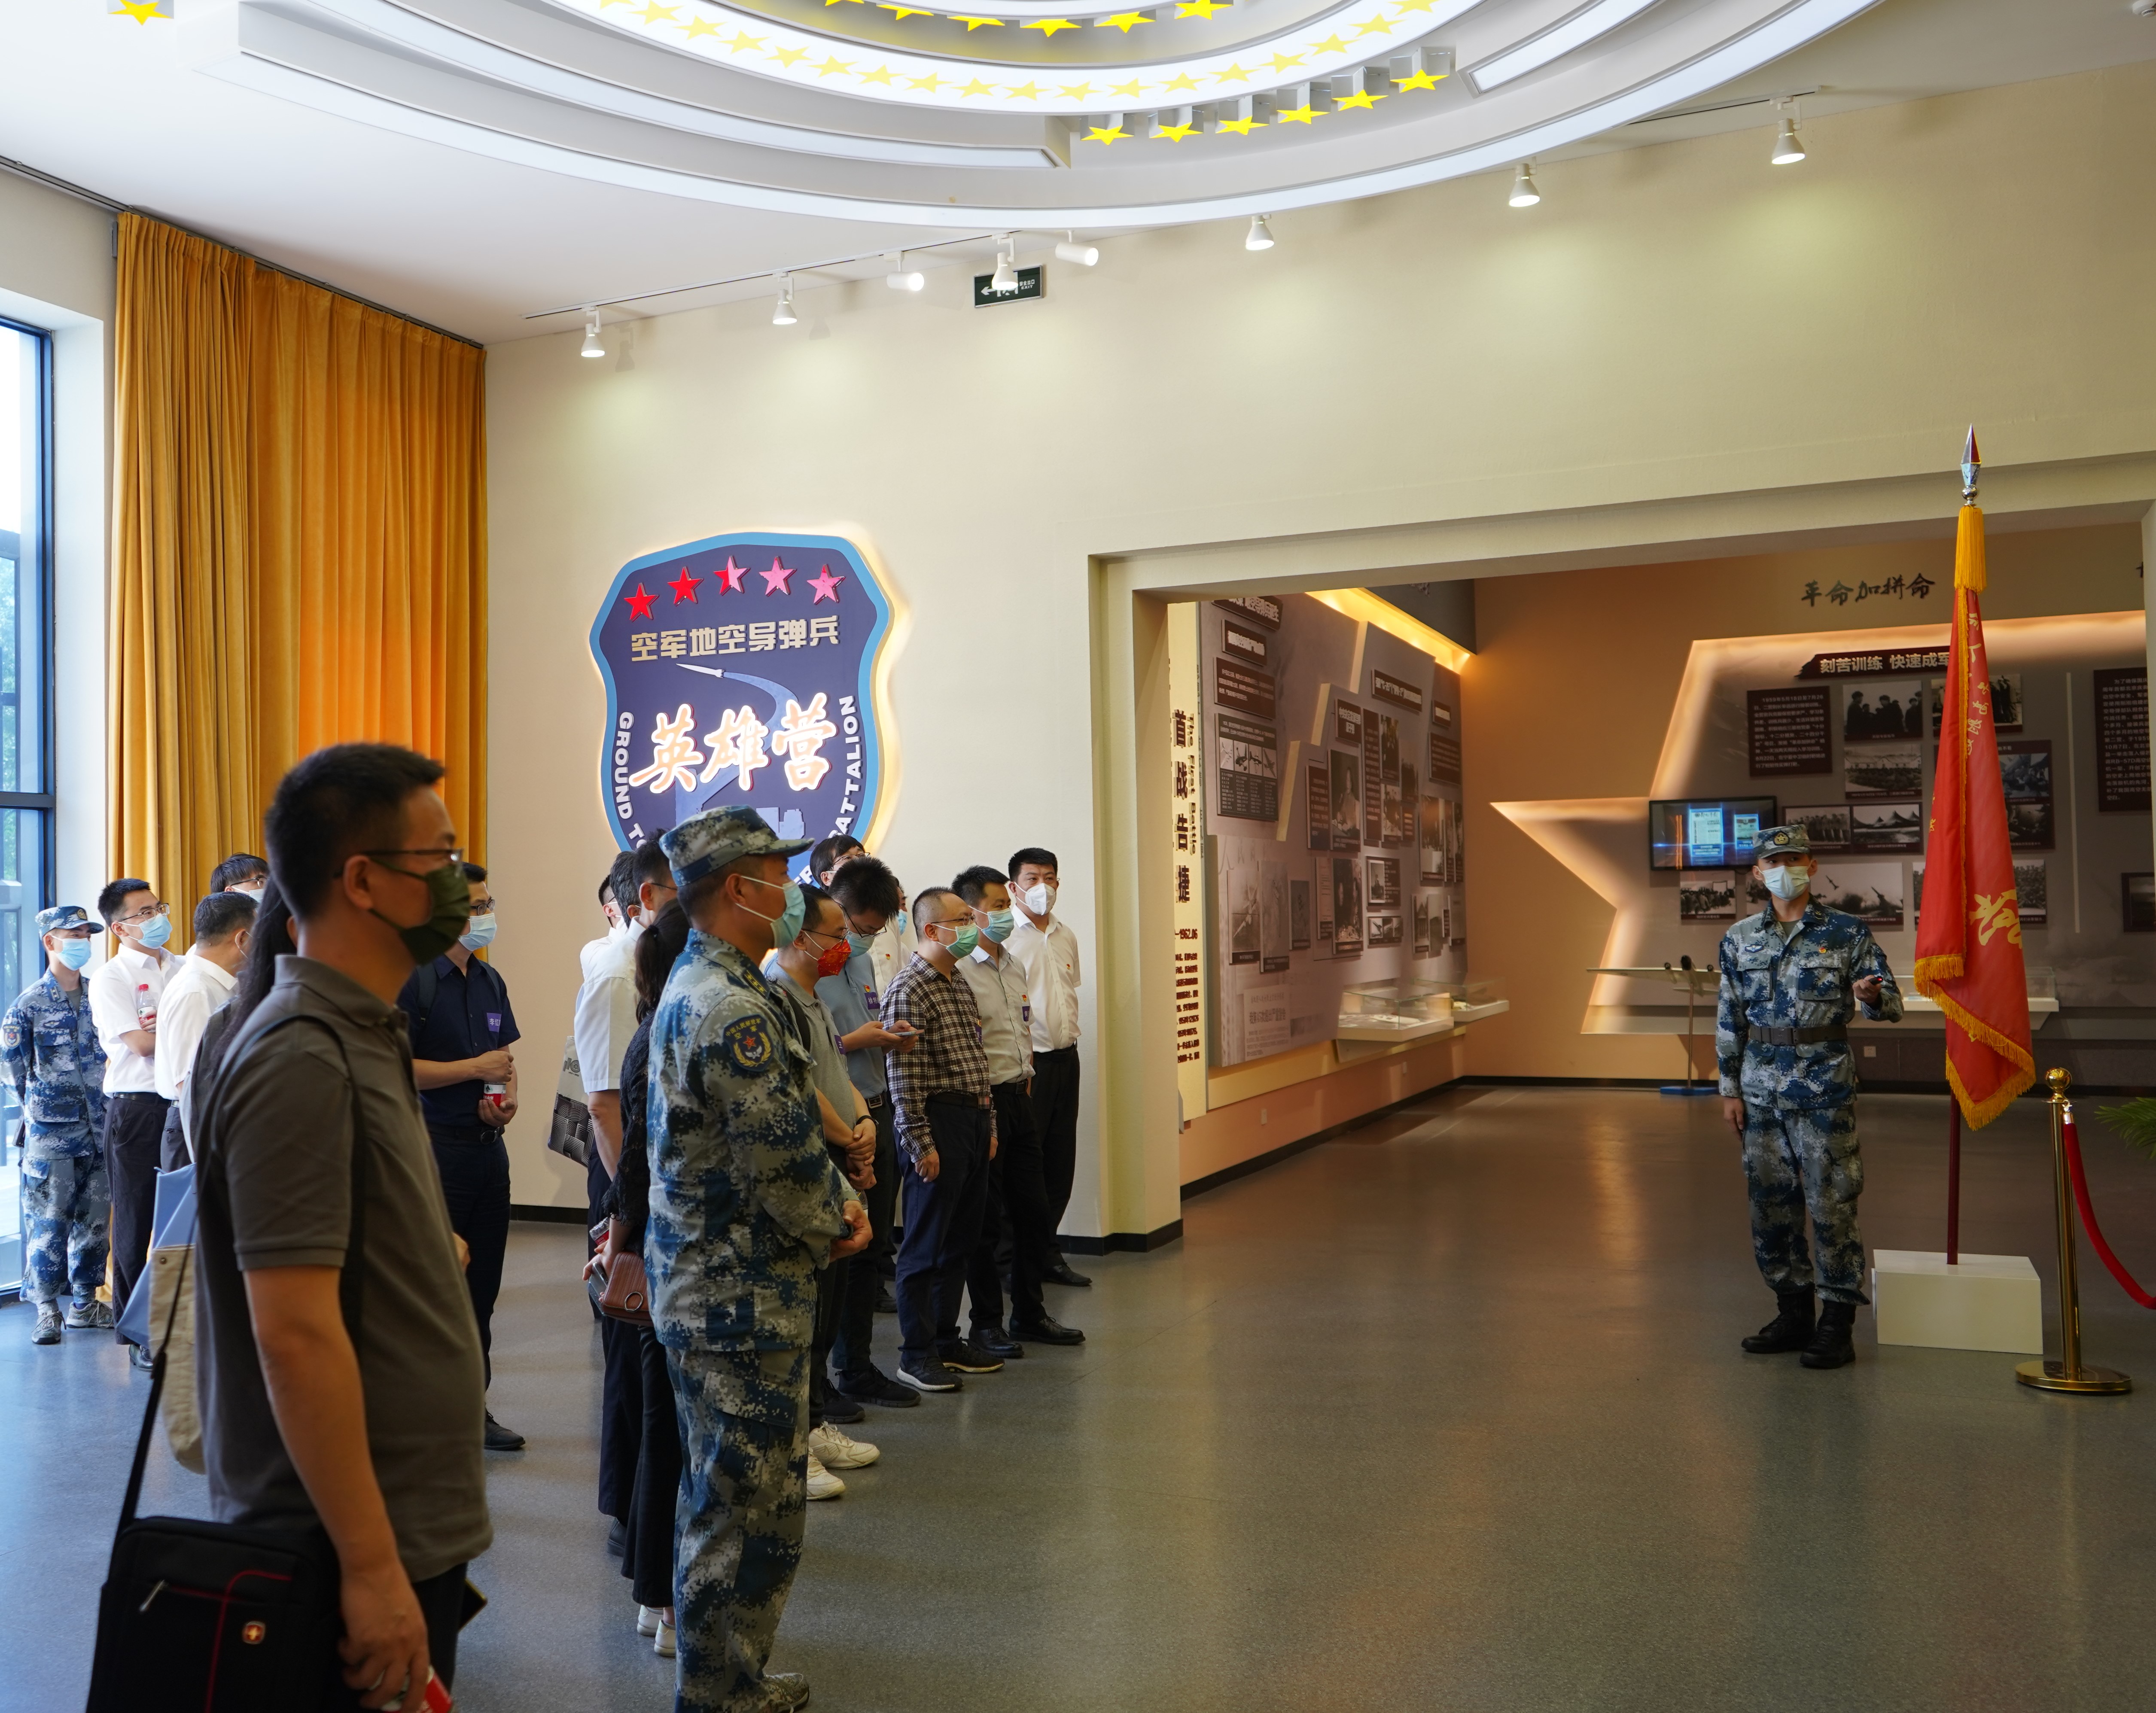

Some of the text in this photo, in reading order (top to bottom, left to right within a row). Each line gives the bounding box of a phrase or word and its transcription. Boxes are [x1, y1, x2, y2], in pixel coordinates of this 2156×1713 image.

[1801, 572, 1935, 607] 革命加拼命
[631, 615, 840, 662] 空军地空导弹兵
[1820, 651, 1950, 674] 刻苦训练 快速成军
[614, 712, 635, 820] GROUND
[628, 692, 838, 794] 英雄营
[1172, 709, 1190, 903] 首战告捷
